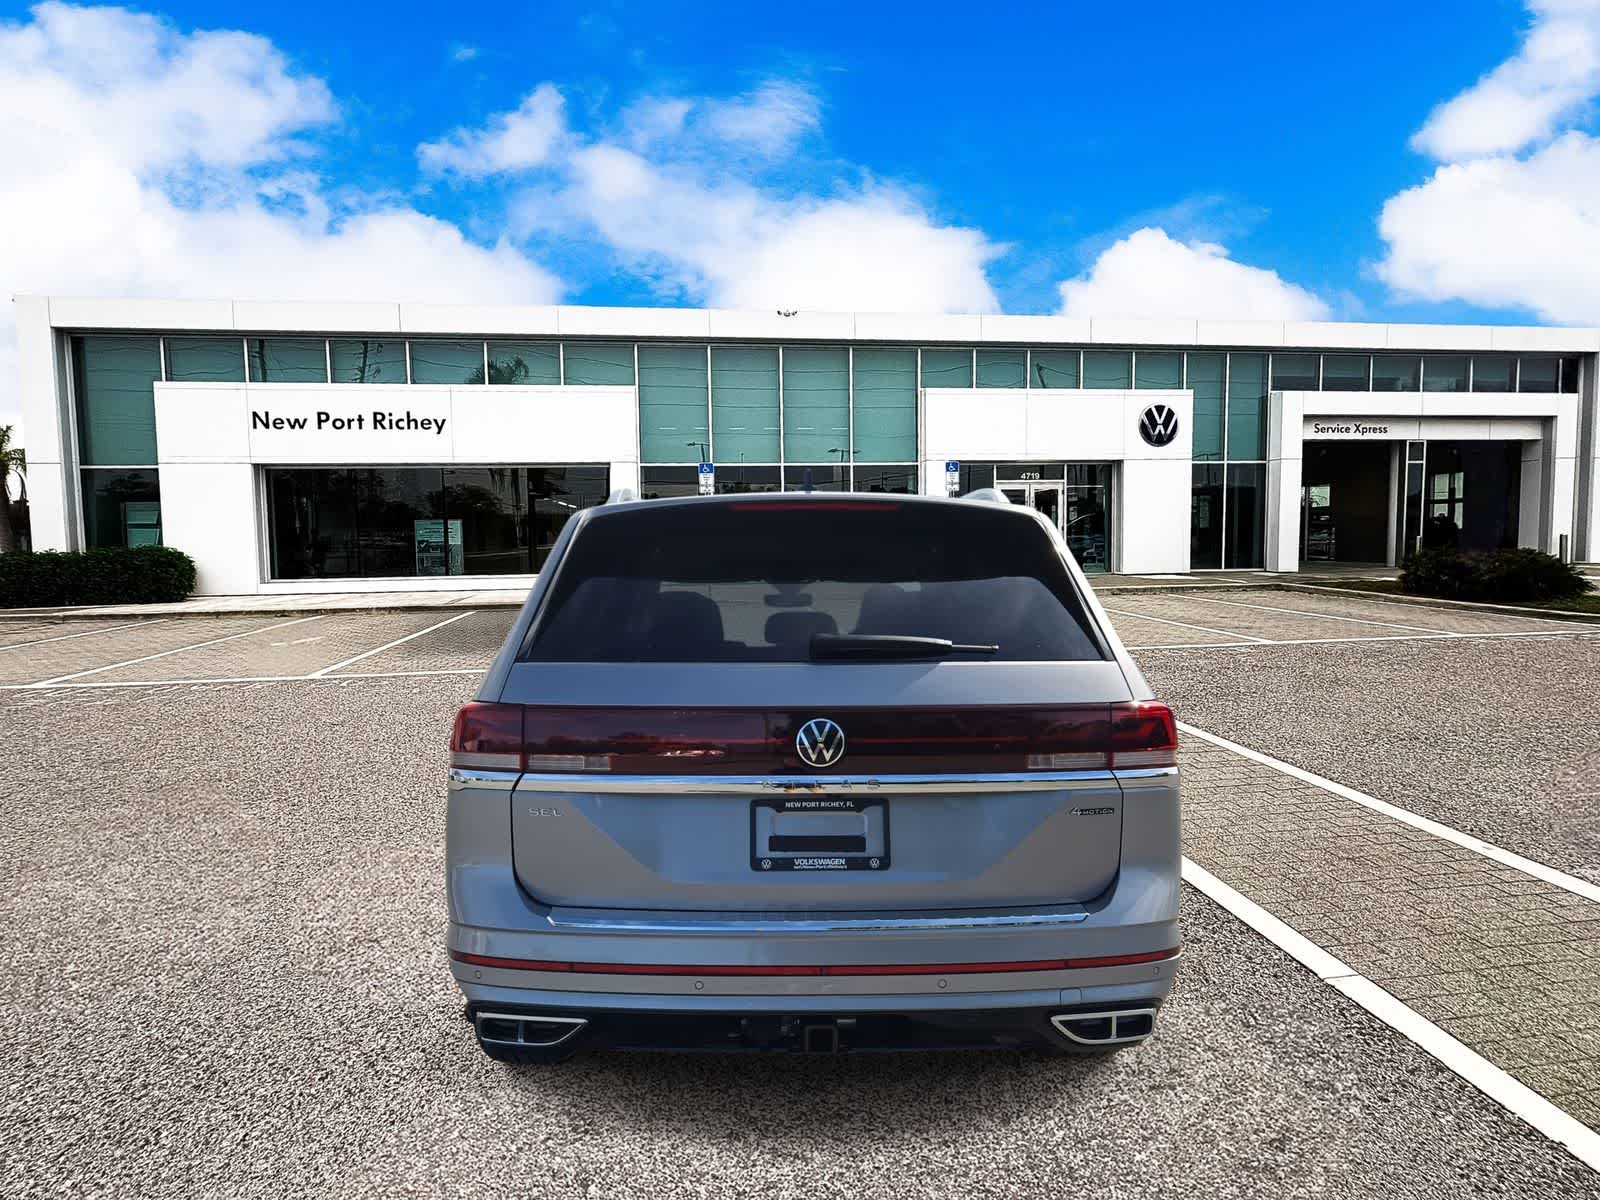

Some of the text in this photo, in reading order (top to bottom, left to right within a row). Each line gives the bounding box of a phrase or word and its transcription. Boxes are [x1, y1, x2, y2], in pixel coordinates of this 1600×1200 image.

[251, 411, 447, 435] New Port Richey
[1313, 423, 1388, 436] Service Xpress
[1020, 472, 1040, 480] 4719
[527, 808, 562, 816] SEL
